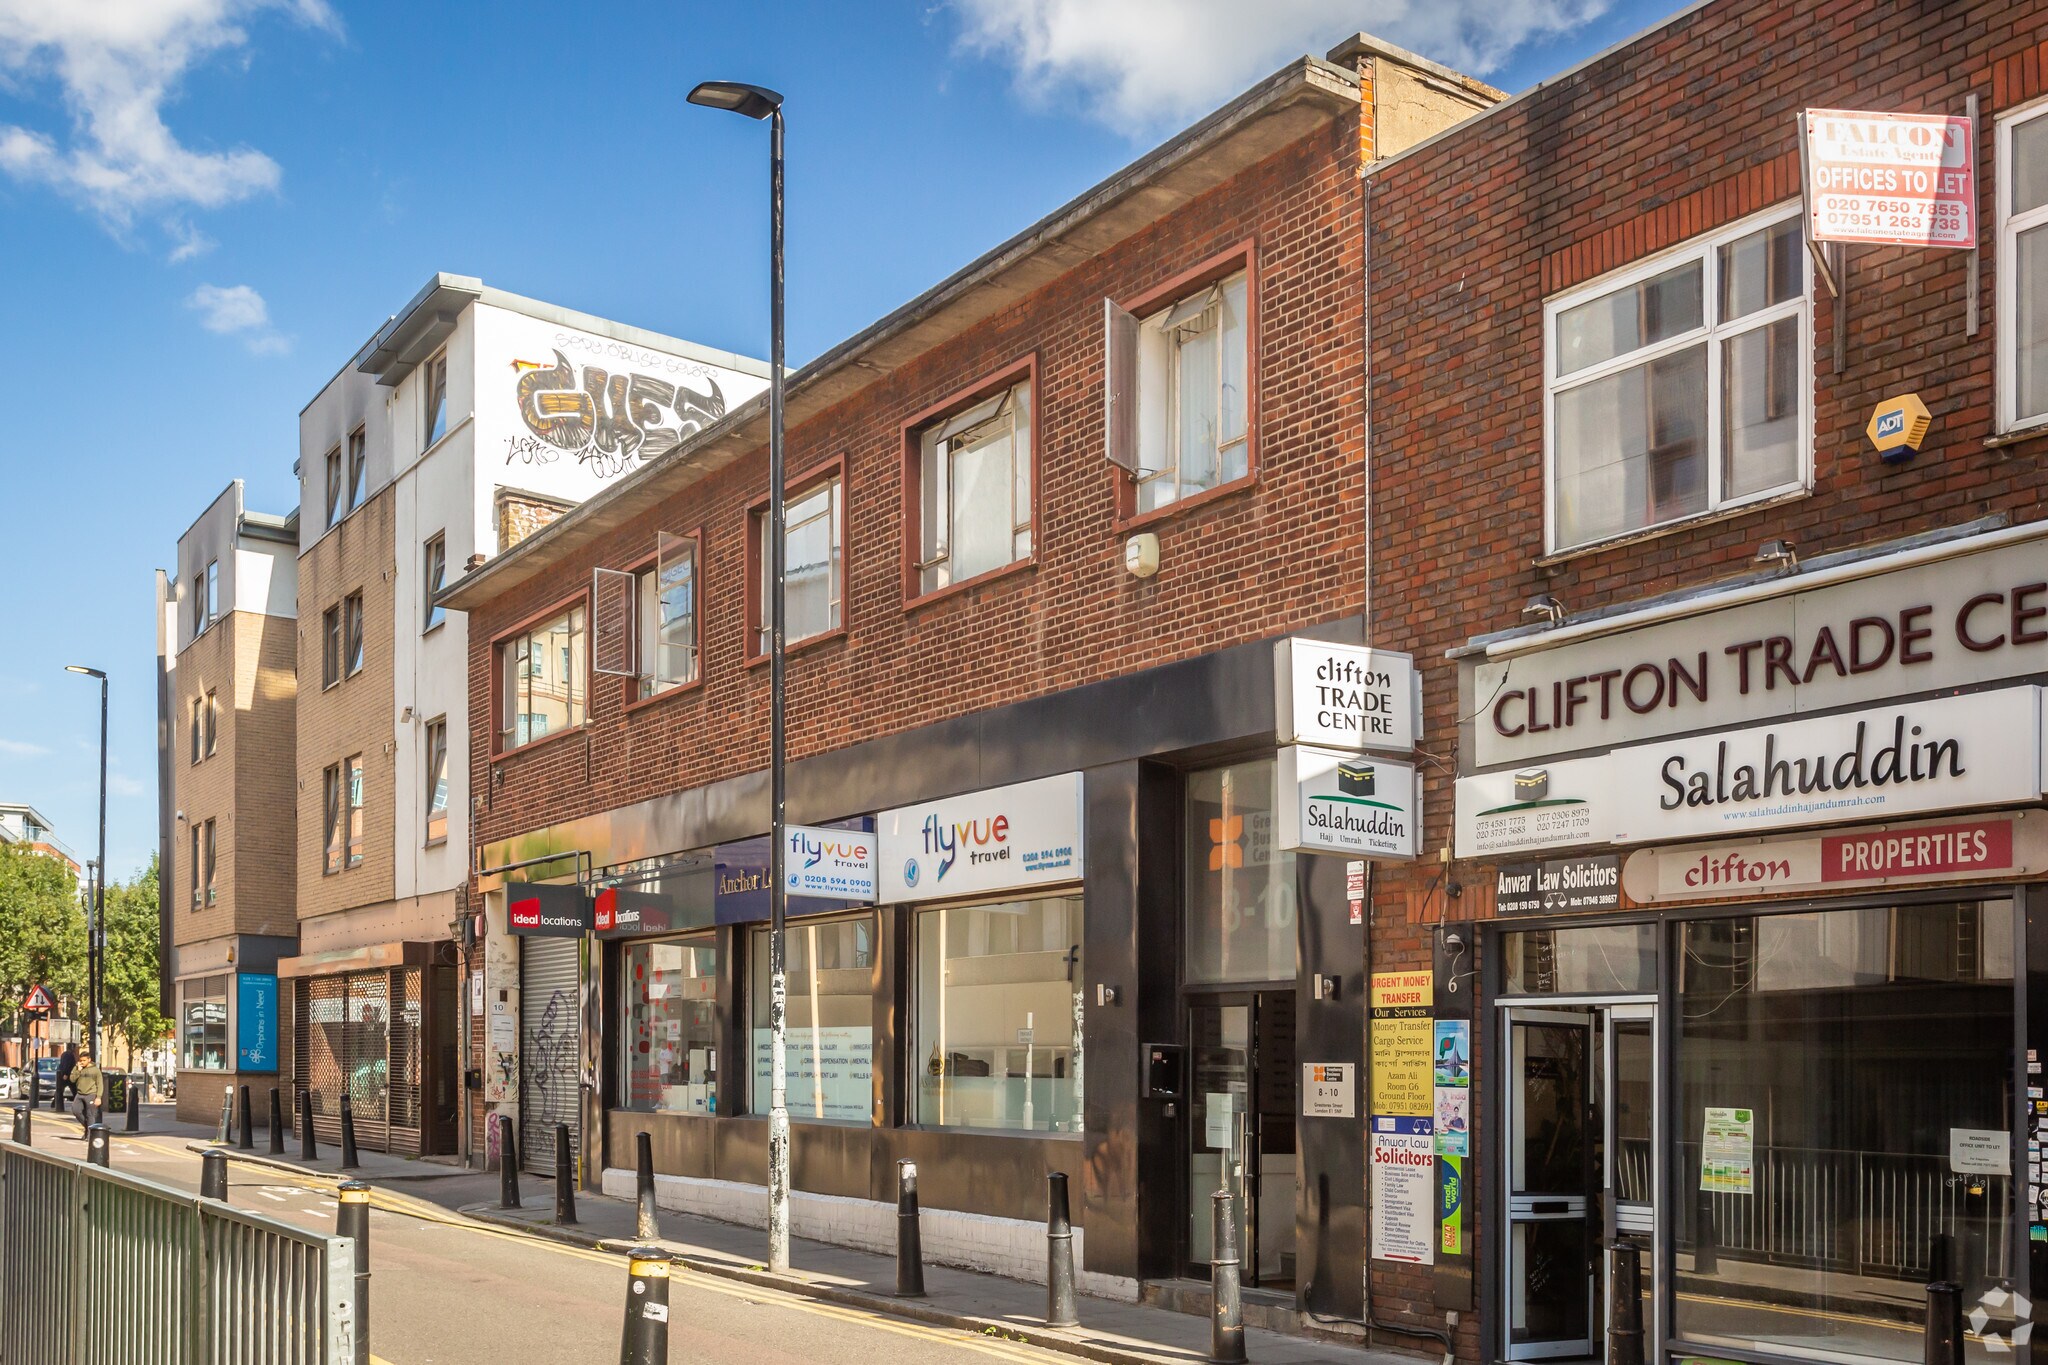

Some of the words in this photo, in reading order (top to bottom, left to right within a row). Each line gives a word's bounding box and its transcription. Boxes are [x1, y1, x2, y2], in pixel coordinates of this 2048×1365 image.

[1826, 122, 1955, 148] FALCON
[1841, 144, 1888, 159] Estate
[1895, 146, 1943, 161] Agents
[1816, 166, 1897, 191] OFFICES
[1902, 170, 1928, 192] TO
[1934, 172, 1967, 194] LET
[1827, 198, 1860, 210] 020
[1867, 200, 1910, 214] 7650
[1917, 202, 1960, 216] 7855
[1828, 213, 1881, 226] 07951
[1890, 216, 1921, 228] 263
[1929, 218, 1960, 230] 738
[1878, 414, 1903, 433] ADT
[1316, 657, 1390, 688] clifton
[1492, 651, 1708, 738] CLIFTON
[1724, 605, 1932, 694] TRADE
[1316, 686, 1392, 714] TRADE
[1318, 711, 1393, 734] CENTRE
[1660, 715, 1965, 812] Salahuddin
[1536, 814, 1550, 822] 077
[1552, 810, 1570, 820] 0306
[1572, 808, 1590, 818] 8979
[1724, 795, 1886, 820] www.salahuddinhajjandumrah.com
[1308, 804, 1405, 838] Salahuddin
[1476, 821, 1489, 830] 075
[1536, 823, 1550, 832] 020
[1552, 820, 1570, 830] 7247
[1320, 832, 1334, 843] Hajj
[1340, 834, 1362, 844] Umrah
[1368, 838, 1397, 850] Ticketing
[1476, 831, 1488, 840] 020
[790, 832, 868, 868] flyvue
[922, 814, 1009, 882] flyvue
[834, 858, 868, 869] travel
[970, 848, 1010, 866] travel
[1685, 853, 1790, 887] clifton
[1841, 829, 1988, 874] PROPERTIES
[718, 870, 758, 896] Anchor
[804, 875, 826, 883] 0208
[1498, 872, 1532, 894] Anwar
[1537, 868, 1560, 891] Law
[1562, 863, 1617, 889] Solicitors
[804, 884, 871, 894] www.flyvue.co.uk
[513, 907, 538, 925] ideal
[540, 915, 582, 927] locations
[596, 910, 610, 925] ideal
[615, 910, 640, 924] locations
[1372, 978, 1401, 988] URGENT
[1404, 976, 1430, 986] MONEY
[1448, 977, 1458, 992] 6
[256, 989, 264, 1009] Need
[1382, 992, 1420, 1004] TRANSFER
[1374, 1008, 1389, 1018] Our
[1394, 1007, 1426, 1017] Services
[1374, 1022, 1398, 1033] Money
[1400, 1020, 1430, 1030] Transfer
[1374, 1036, 1394, 1048] Cargo
[1397, 1036, 1424, 1045] Service
[1388, 1072, 1406, 1080] Azam
[1408, 1072, 1418, 1080] Ali
[1318, 1088, 1322, 1096] 8
[1330, 1088, 1338, 1096] 10
[1387, 1082, 1406, 1090] Room
[1408, 1082, 1419, 1090] G6
[1379, 1092, 1405, 1100] Ground
[1408, 1092, 1426, 1100] Floor
[1373, 1102, 1388, 1110] Mob:
[1378, 1135, 1408, 1148] Anwar
[1410, 1137, 1428, 1148] Law
[1375, 1146, 1432, 1166] Solicitors
